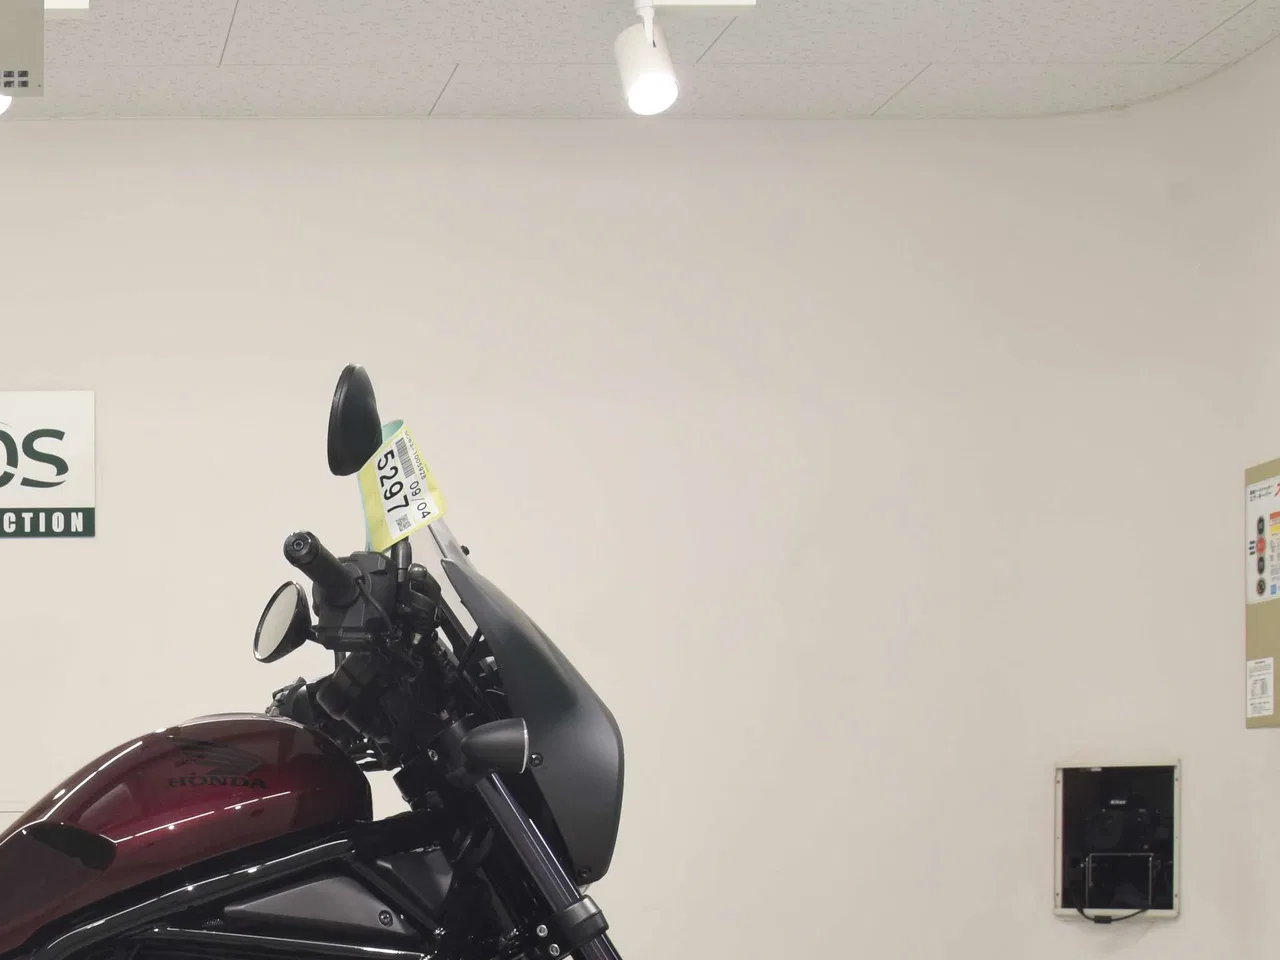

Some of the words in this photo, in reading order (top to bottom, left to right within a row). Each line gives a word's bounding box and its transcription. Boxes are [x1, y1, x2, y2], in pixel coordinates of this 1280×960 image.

[377, 449, 410, 513] 5297
[409, 480, 432, 519] 09/04
[167, 775, 267, 789] HONDA
